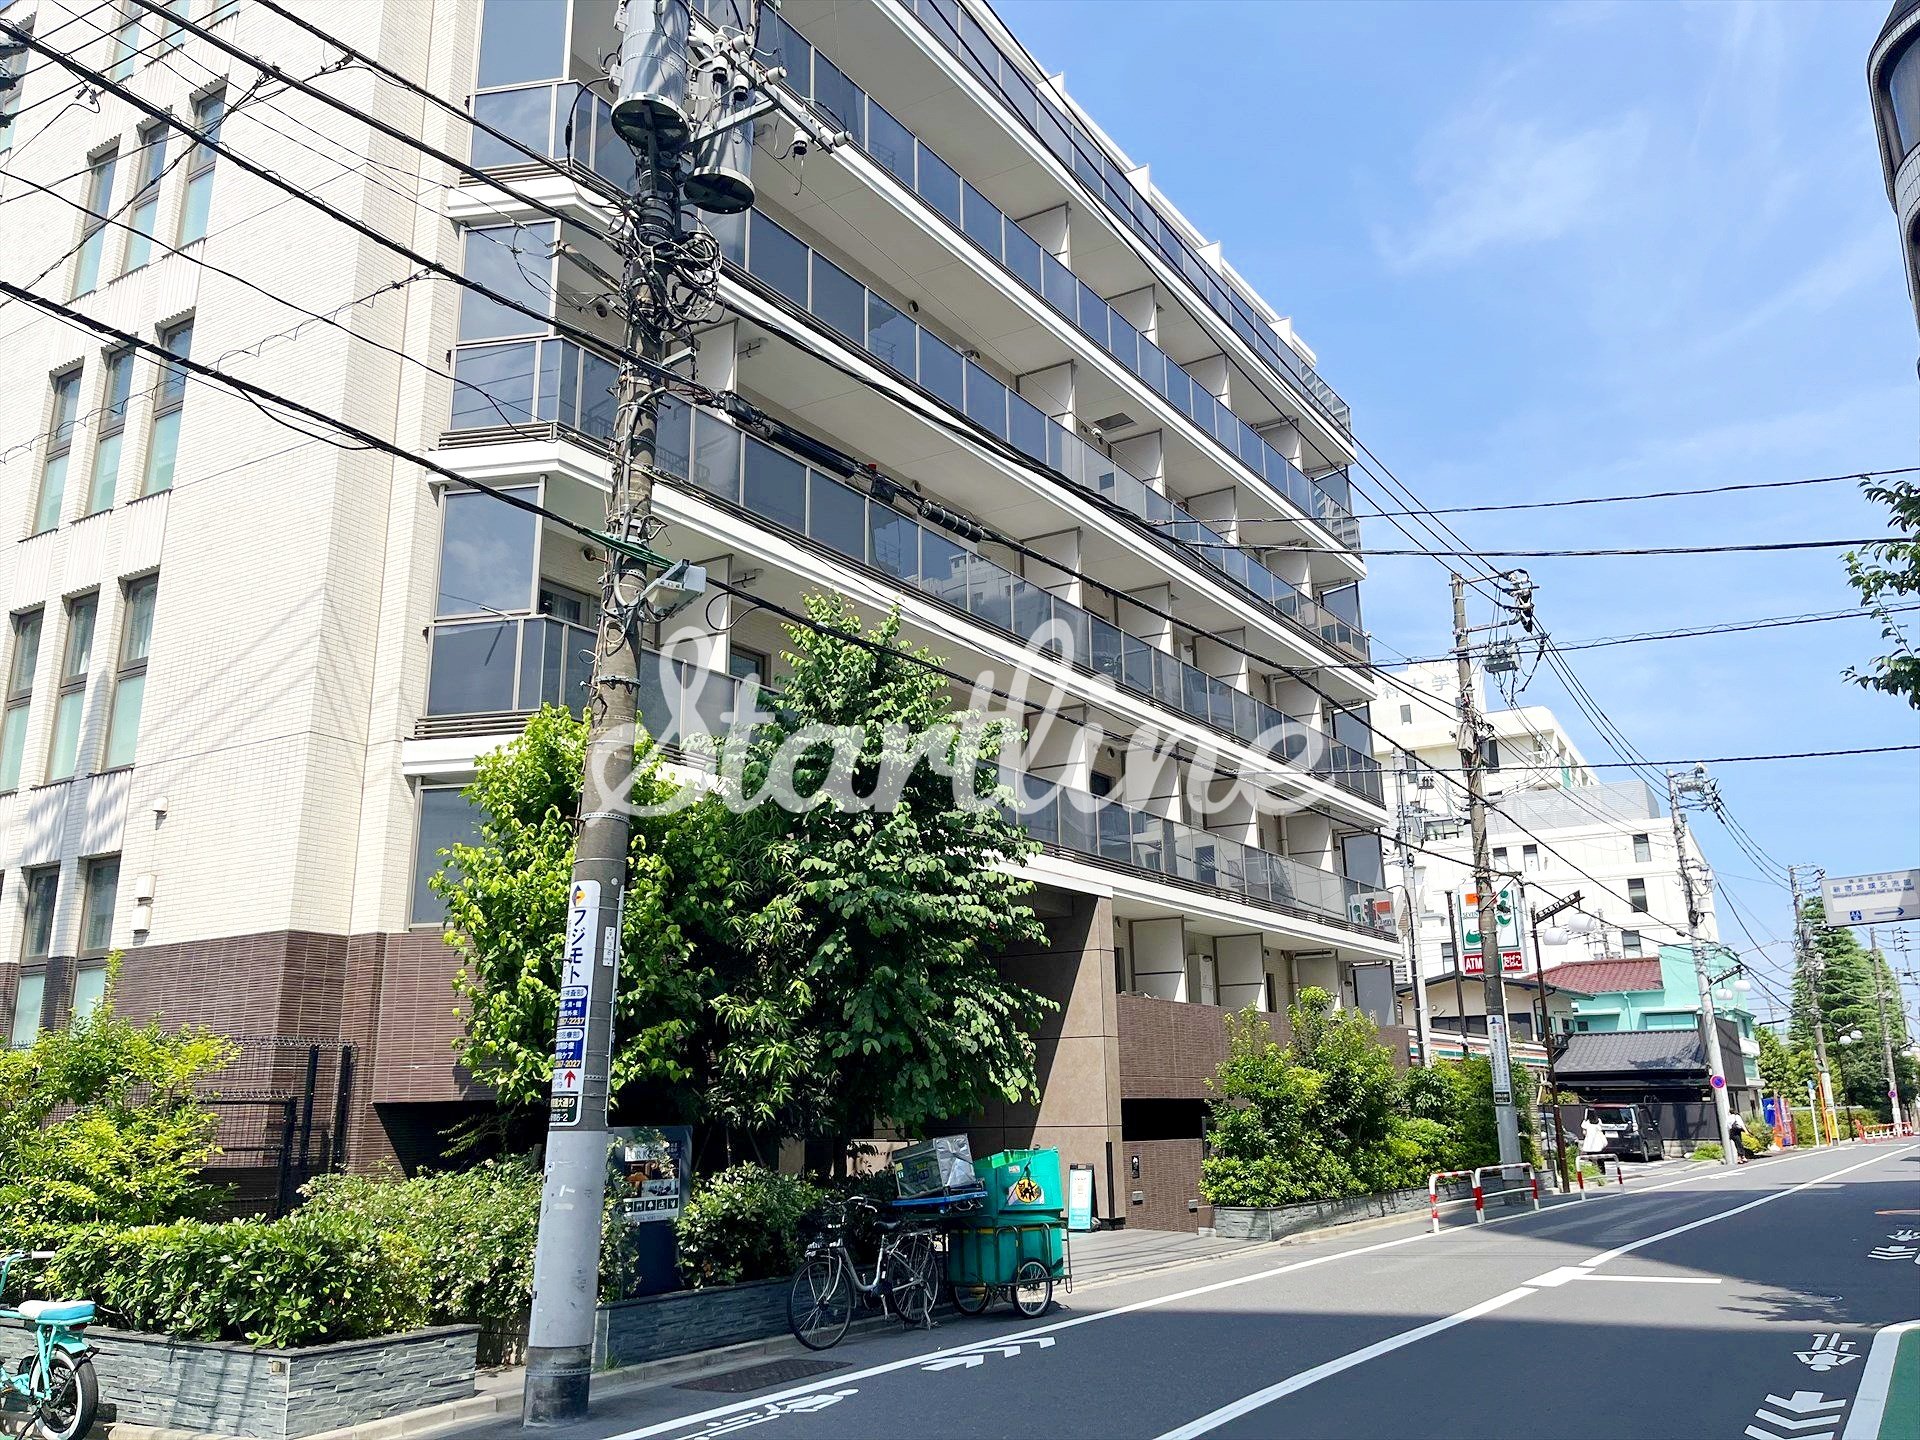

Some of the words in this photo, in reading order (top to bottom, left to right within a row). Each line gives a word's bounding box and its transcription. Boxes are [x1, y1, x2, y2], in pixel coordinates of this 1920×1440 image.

[570, 909, 587, 984] フジモト
[1465, 956, 1483, 970] ATM
